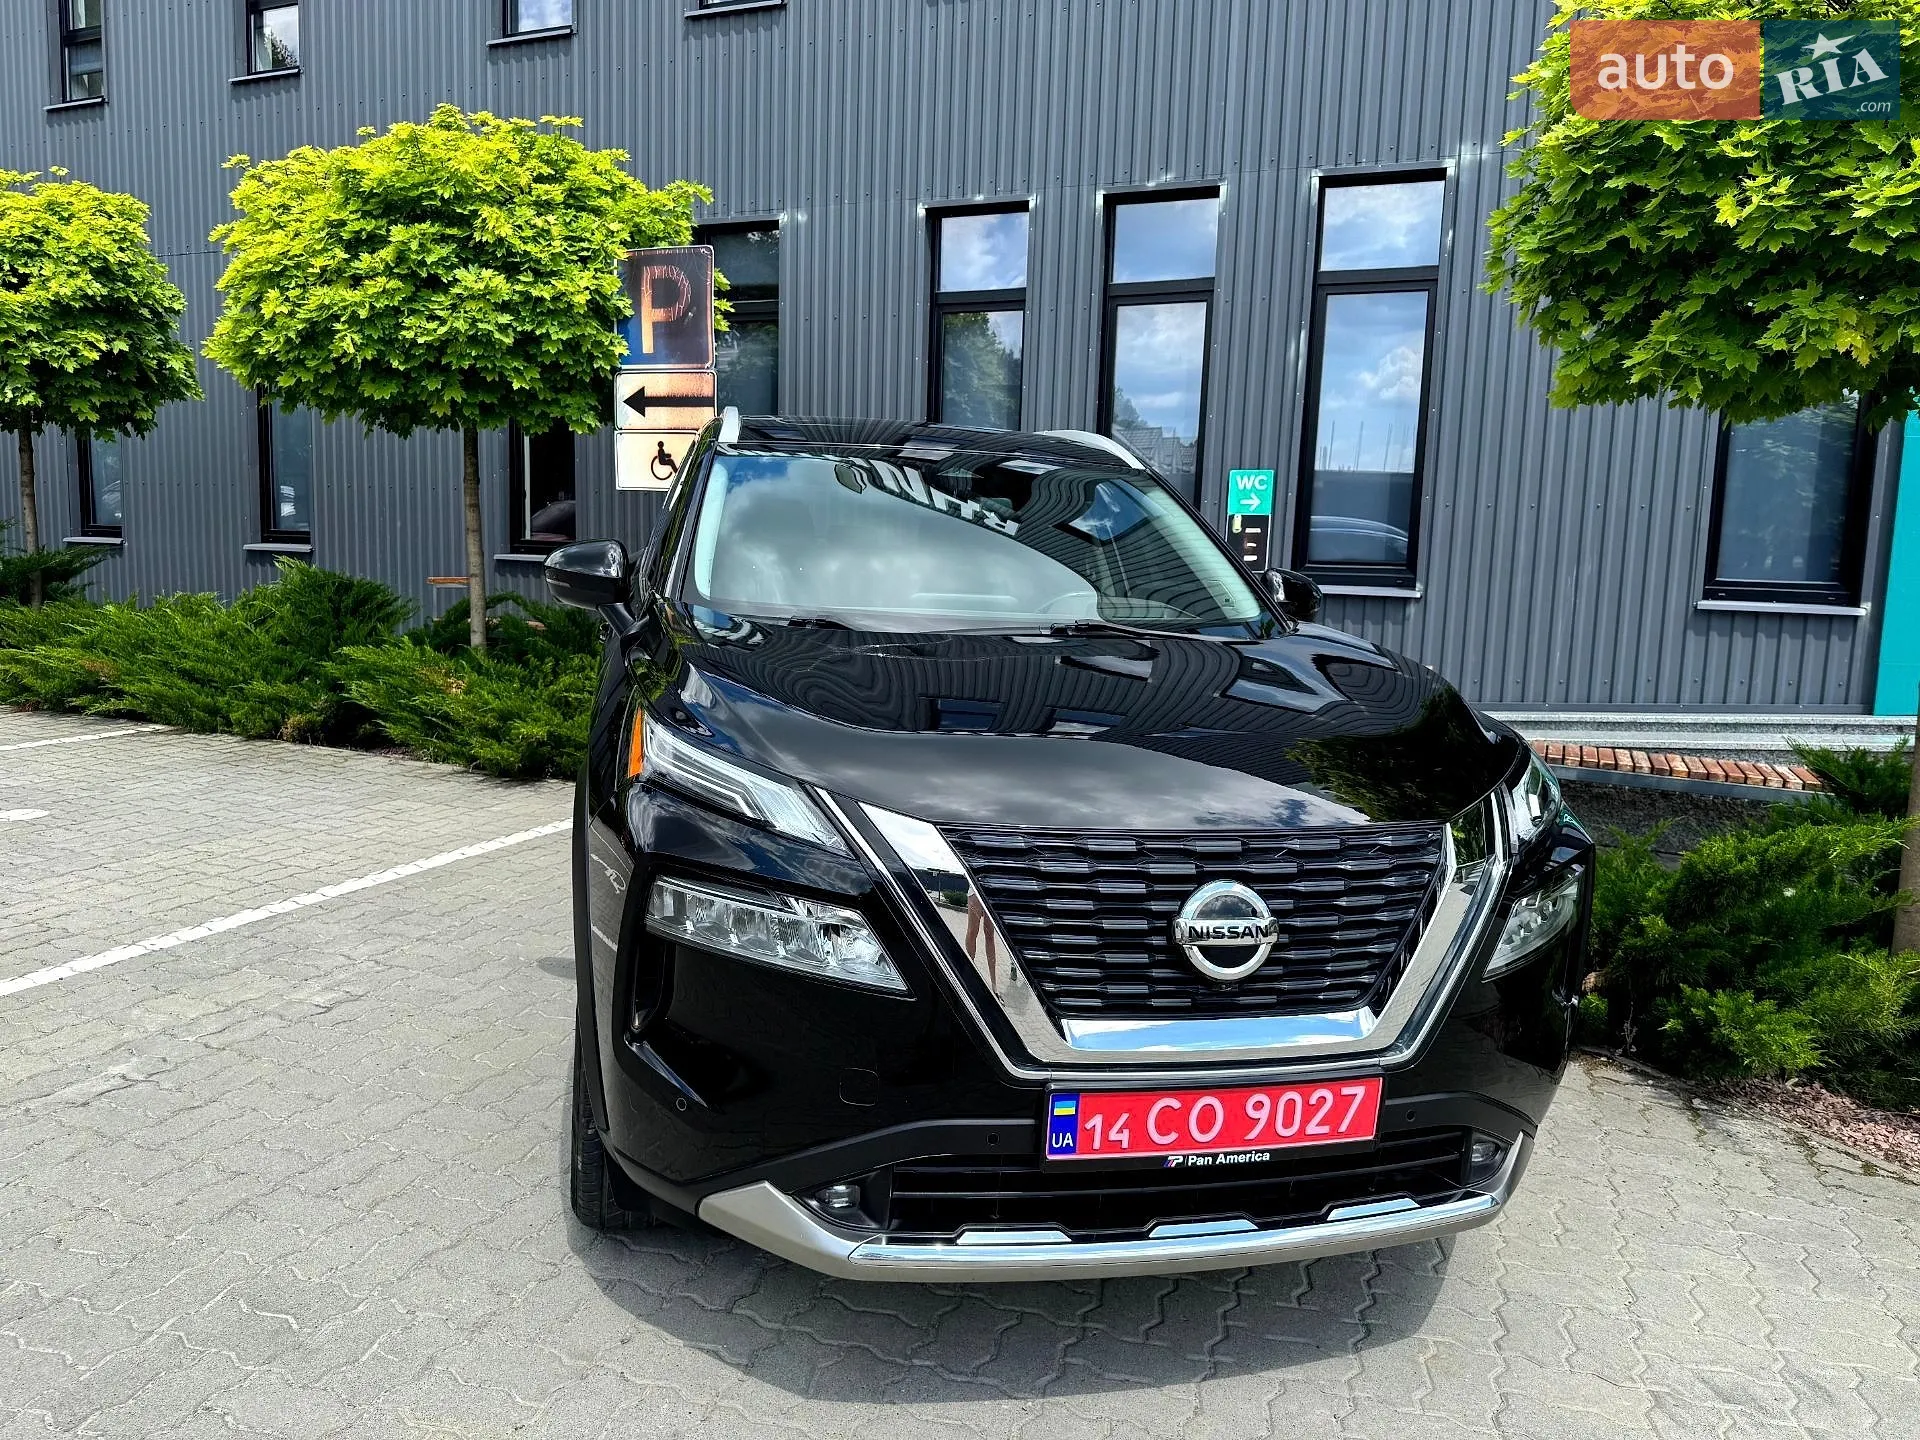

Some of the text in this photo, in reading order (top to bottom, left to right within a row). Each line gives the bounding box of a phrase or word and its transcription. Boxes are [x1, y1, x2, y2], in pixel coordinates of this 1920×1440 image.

[641, 264, 692, 354] P
[1235, 475, 1268, 490] WC
[1188, 925, 1269, 939] NISSAN
[1084, 1085, 1366, 1150] 14 CO 9027
[1051, 1133, 1074, 1149] UA
[1188, 1155, 1213, 1166] Pan
[1216, 1151, 1270, 1165] America
